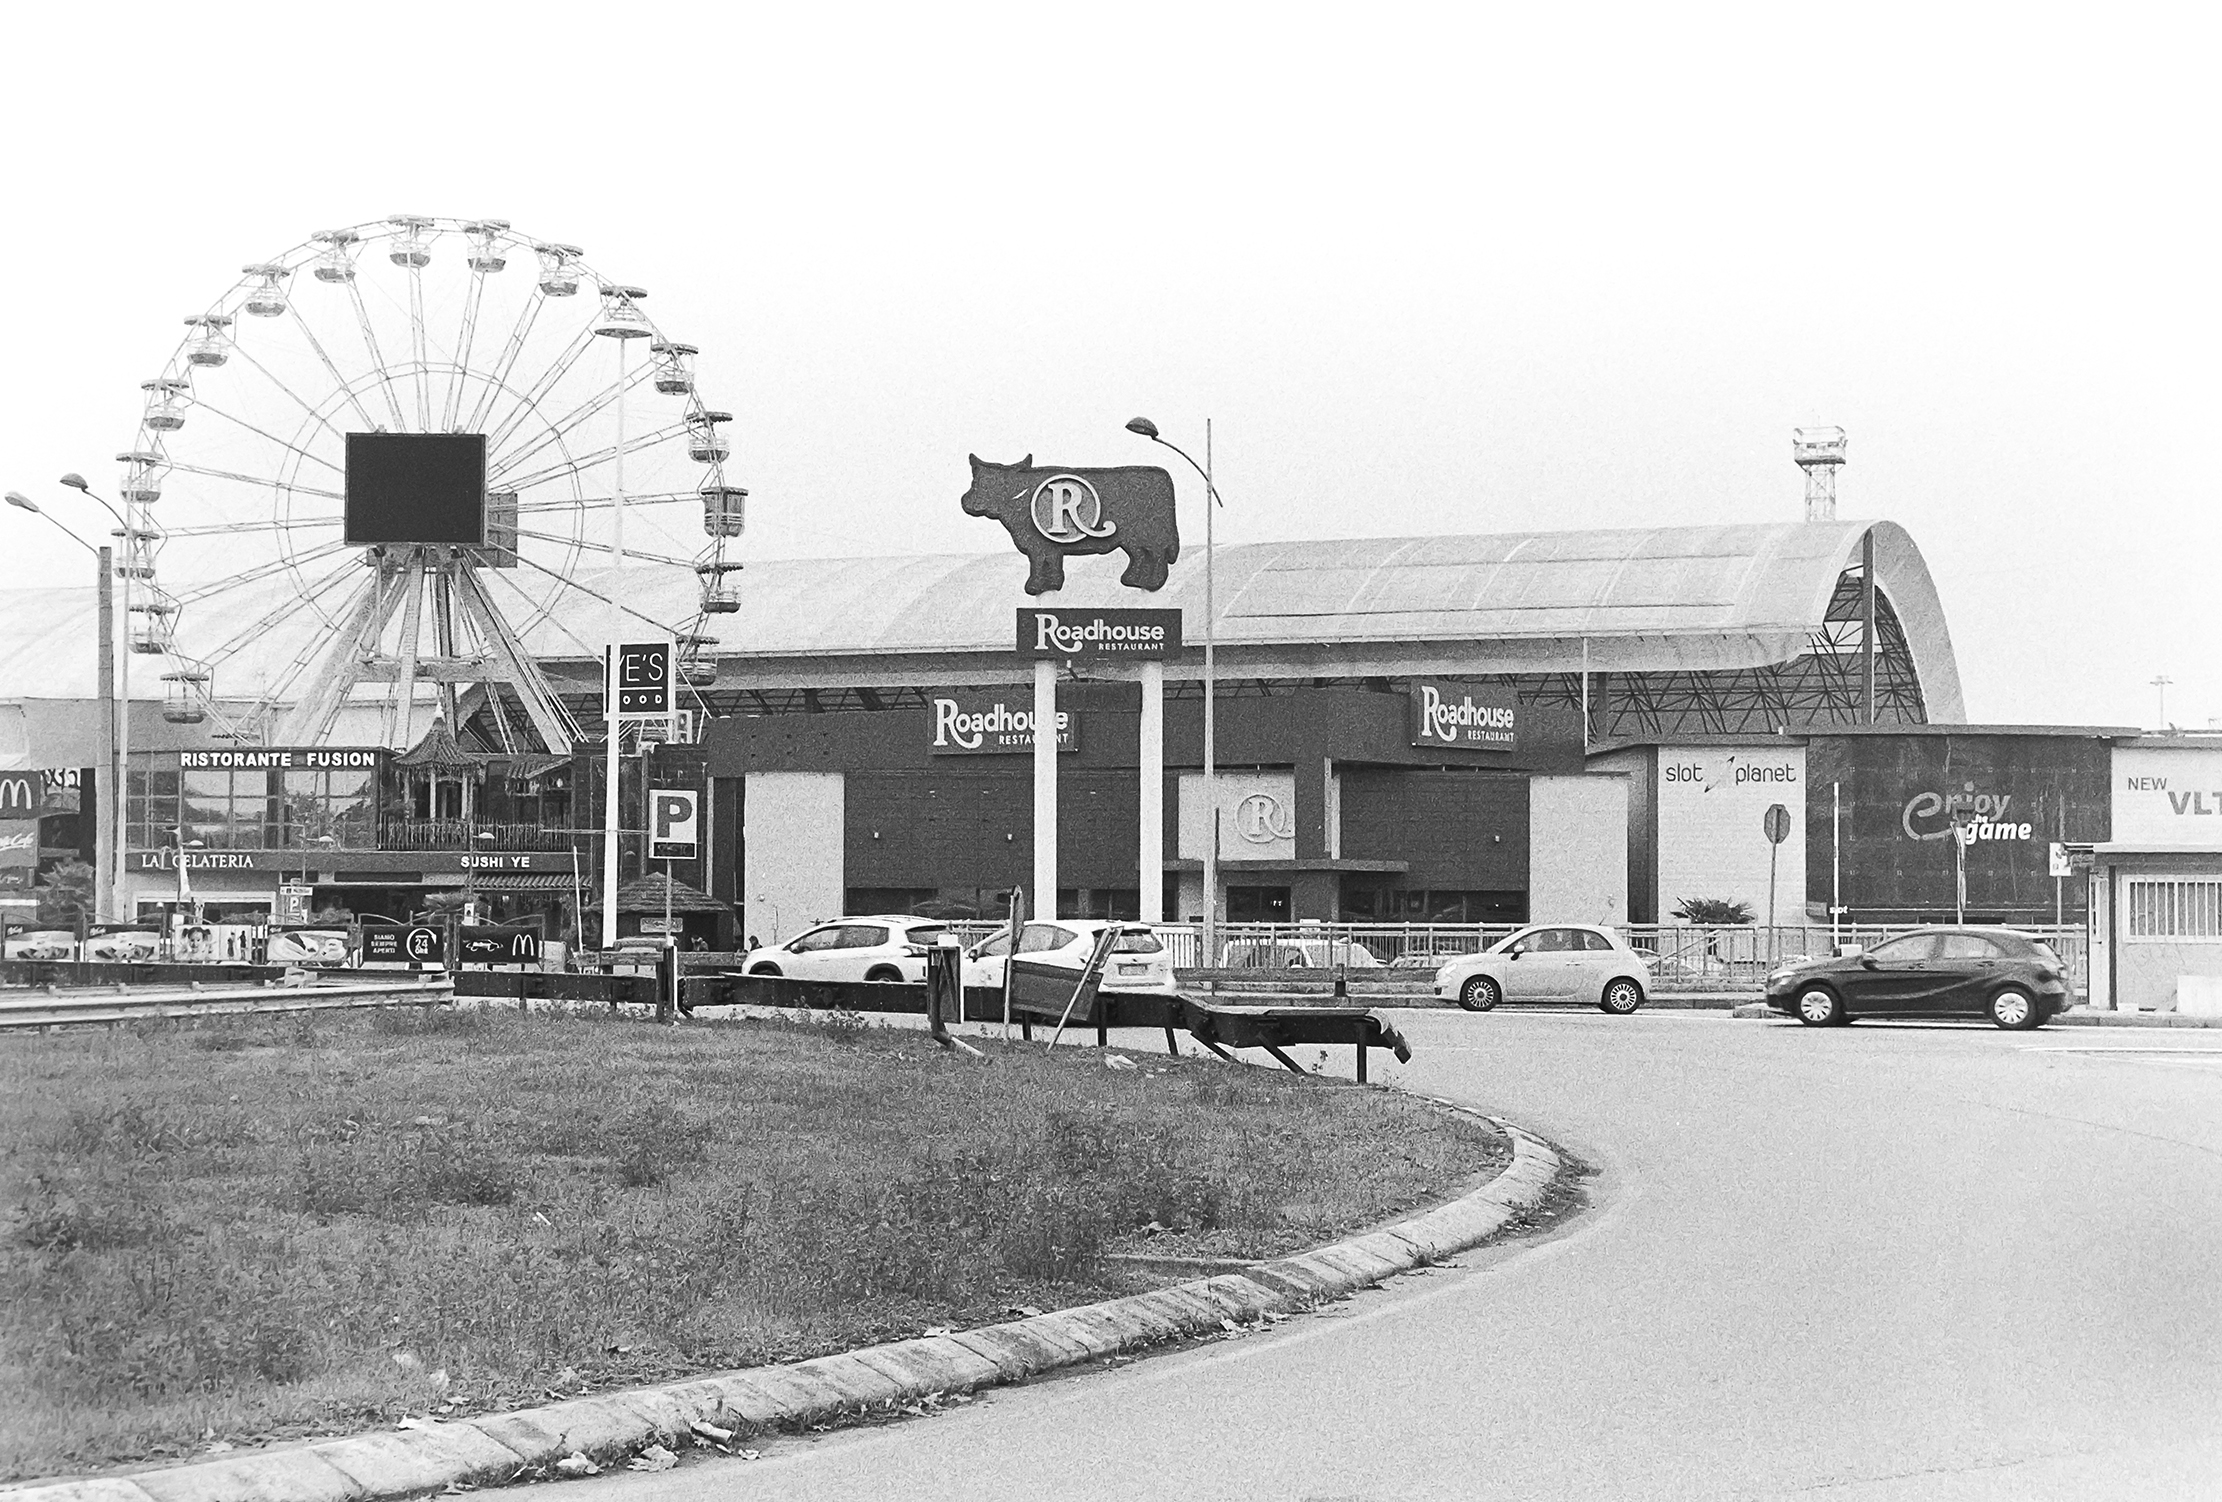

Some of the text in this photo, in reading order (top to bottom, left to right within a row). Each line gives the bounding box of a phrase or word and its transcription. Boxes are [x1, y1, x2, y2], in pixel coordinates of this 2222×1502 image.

[1034, 613, 1165, 653] Roadhouse
[1098, 642, 1165, 651] RESTAURANT
[622, 694, 662, 705] OOD
[1421, 686, 1515, 742] Roadhouse
[933, 698, 1069, 749] Roadhoue
[999, 733, 1069, 745] RESTANT
[1467, 729, 1515, 743] RESTAURANT
[181, 752, 375, 767] RISTORANTE FUSION
[1666, 762, 1797, 786] slot planet
[2128, 777, 2168, 790] NEW
[657, 795, 693, 838] P
[1965, 822, 2033, 846] game
[142, 855, 160, 868] LA
[460, 856, 530, 868] SUSHI YE
[1829, 905, 1849, 914] sot
[415, 937, 429, 948] 24
